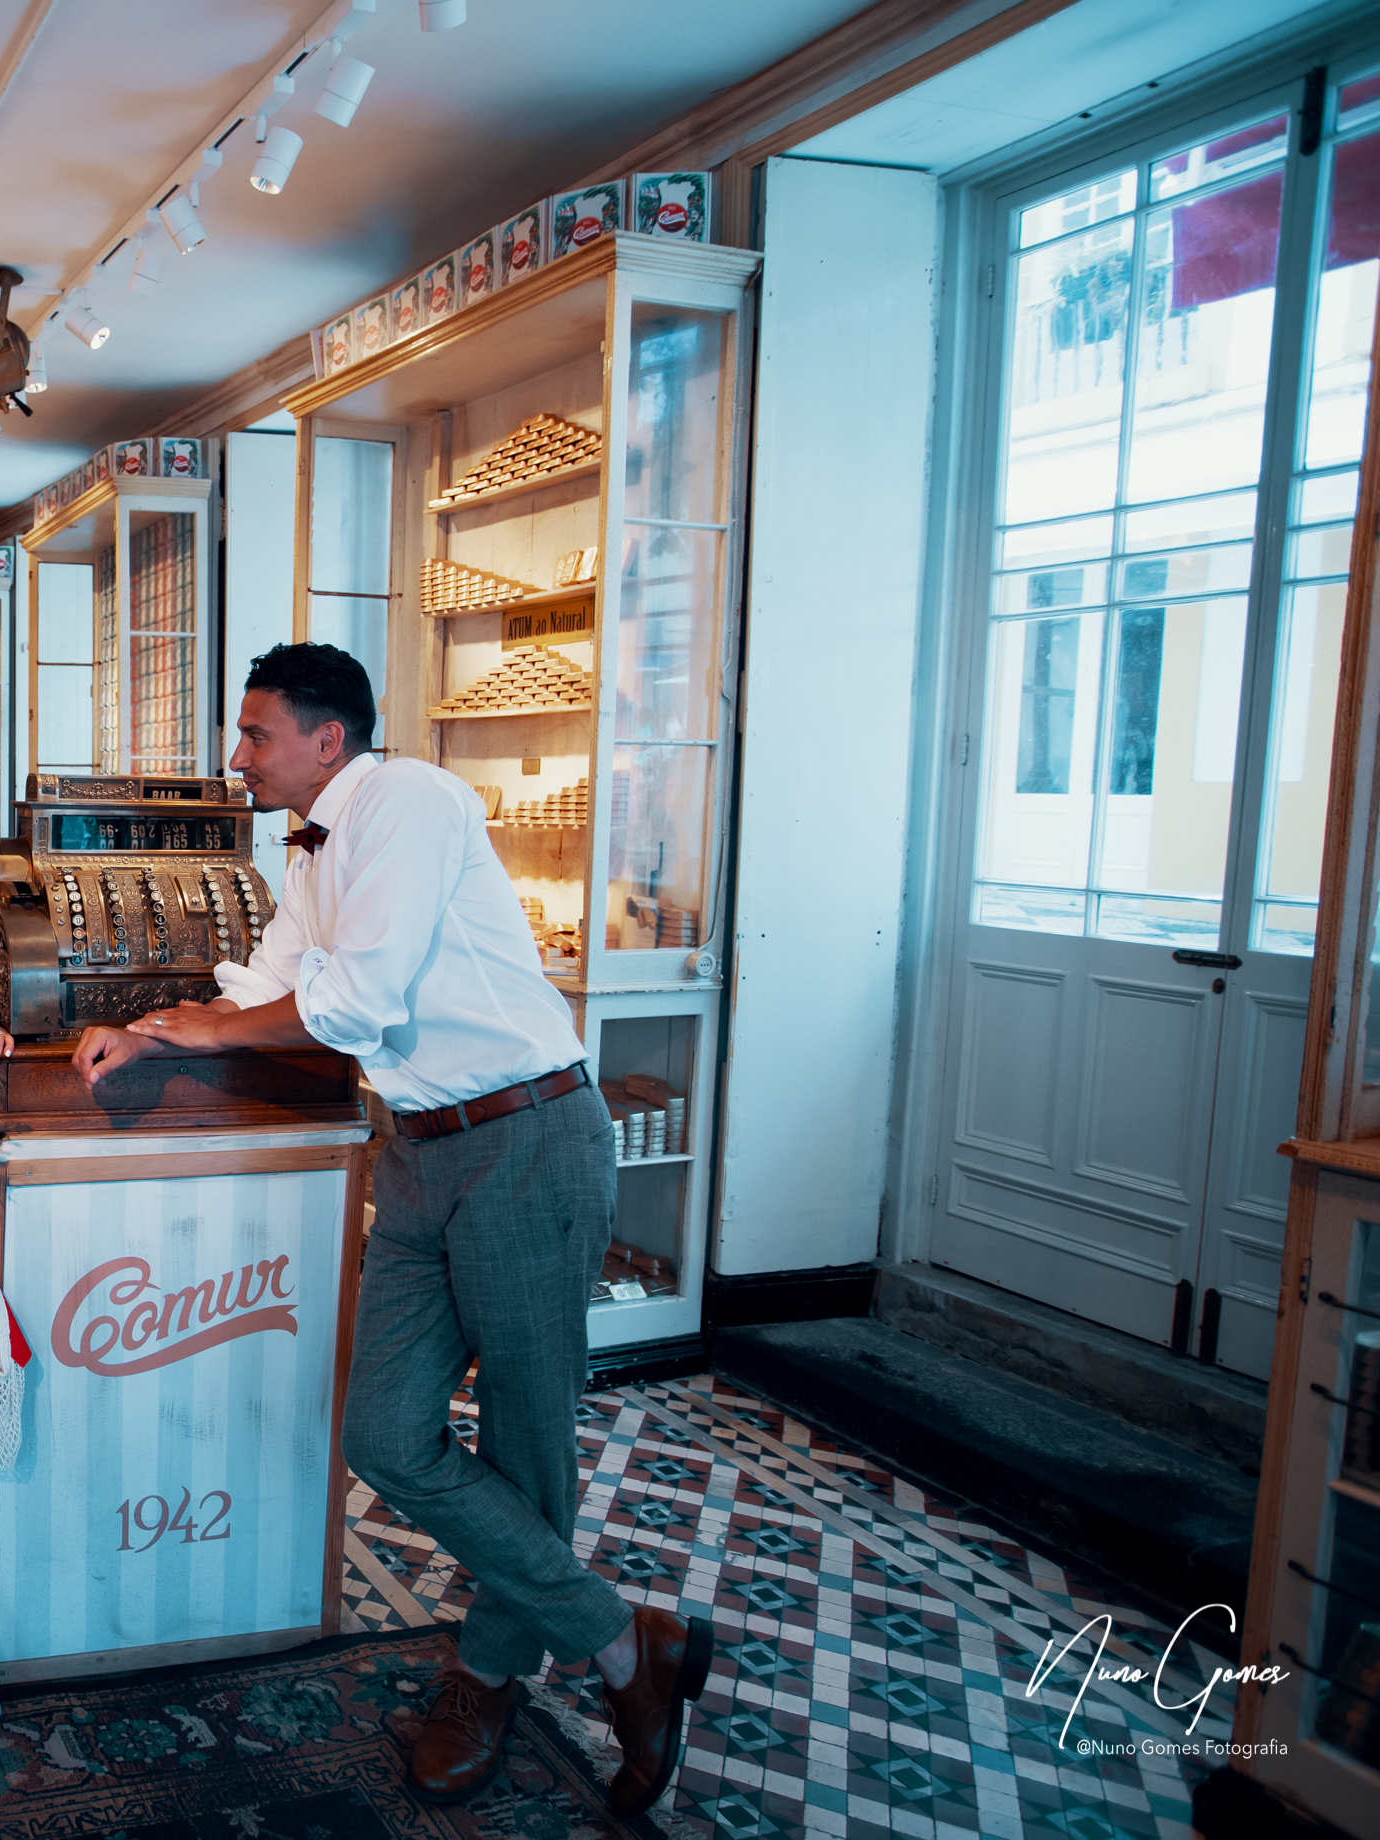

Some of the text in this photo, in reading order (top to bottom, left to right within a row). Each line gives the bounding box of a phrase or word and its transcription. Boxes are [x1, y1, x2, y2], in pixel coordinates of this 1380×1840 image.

[508, 606, 586, 641] ATUM ao Natural
[173, 834, 188, 849] 65
[206, 834, 221, 849] 55
[51, 1254, 298, 1377] Comur
[116, 1486, 232, 1554] 1942
